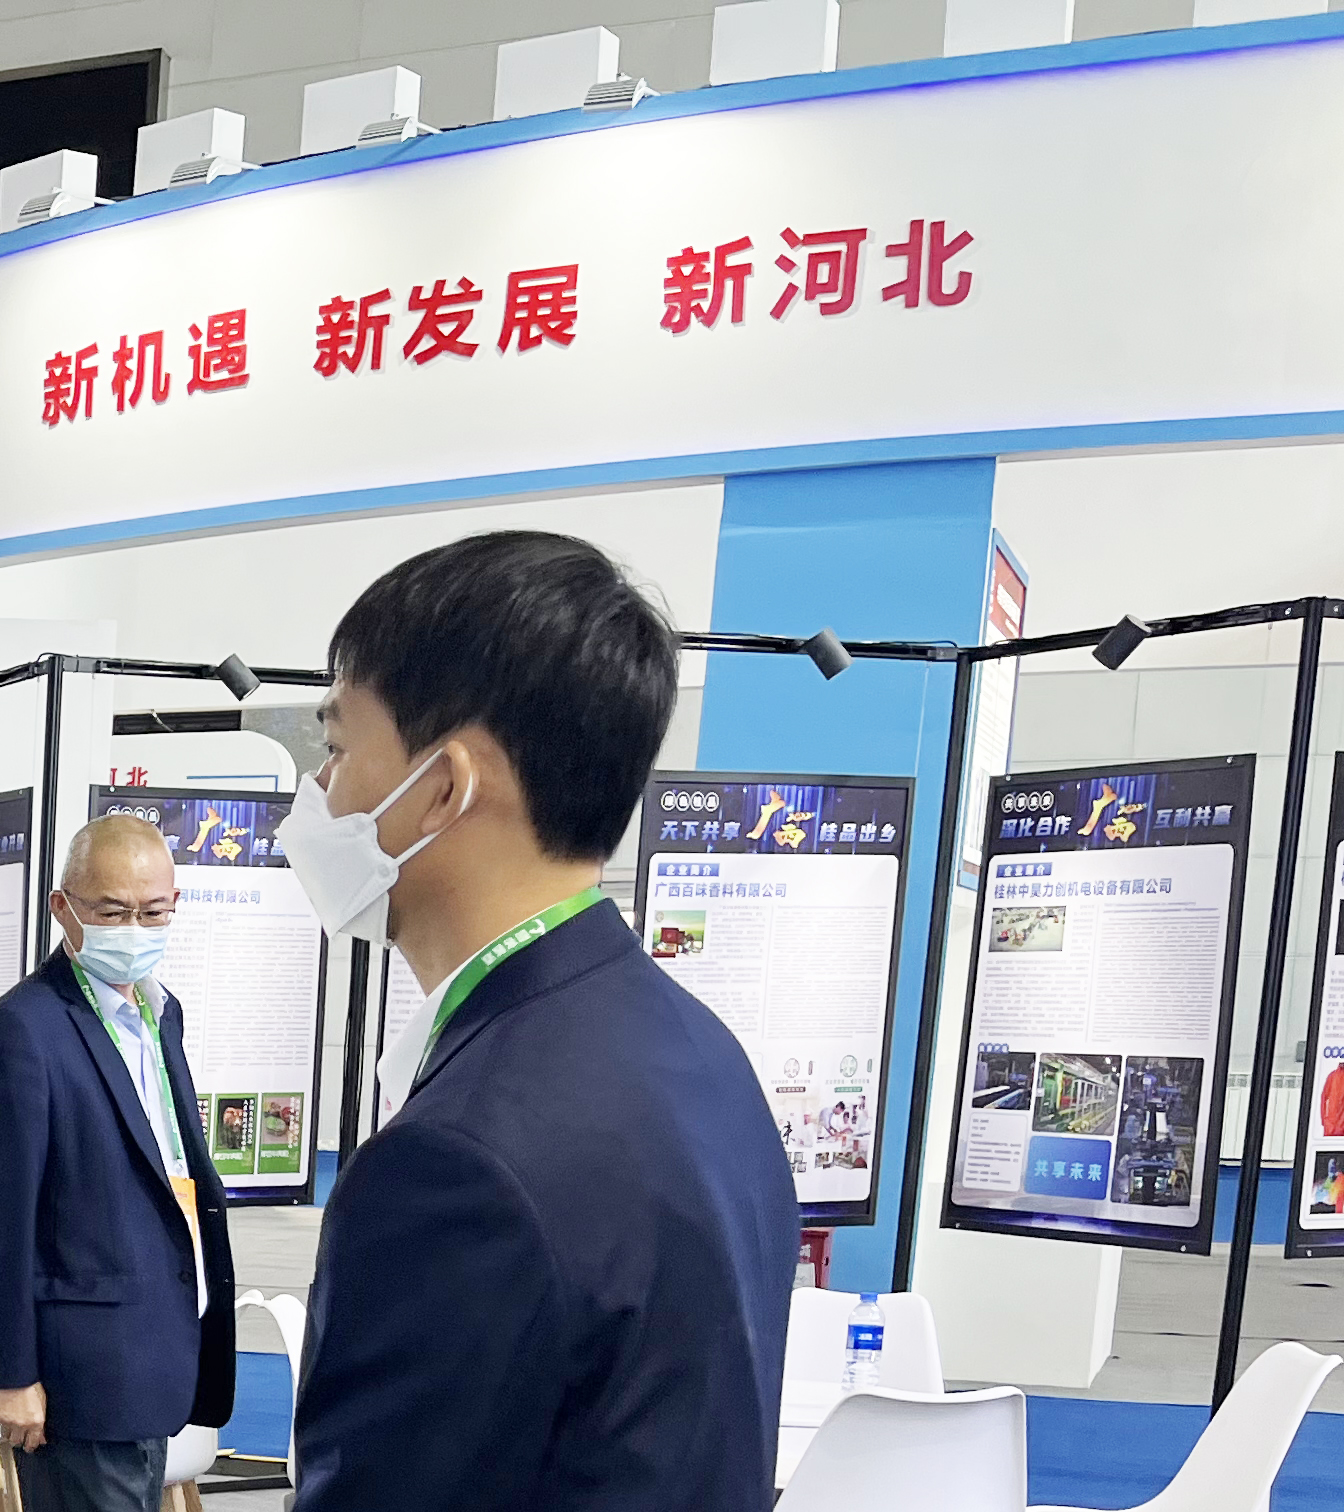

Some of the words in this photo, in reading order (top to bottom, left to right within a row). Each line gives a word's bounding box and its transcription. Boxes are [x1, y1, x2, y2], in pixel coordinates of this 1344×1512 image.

[40, 308, 251, 429] 新机遇
[313, 263, 580, 380] 新发展
[661, 218, 974, 336] 新河北
[186, 806, 243, 861] 广西
[659, 820, 741, 841] 天下共享
[746, 789, 807, 849] 广西
[819, 822, 897, 843] 桂品出乡
[1000, 815, 1072, 839] 深化合作
[1078, 784, 1137, 843] 广西
[1154, 804, 1234, 830] 互利共赢
[1033, 1159, 1104, 1182] 共享未来
